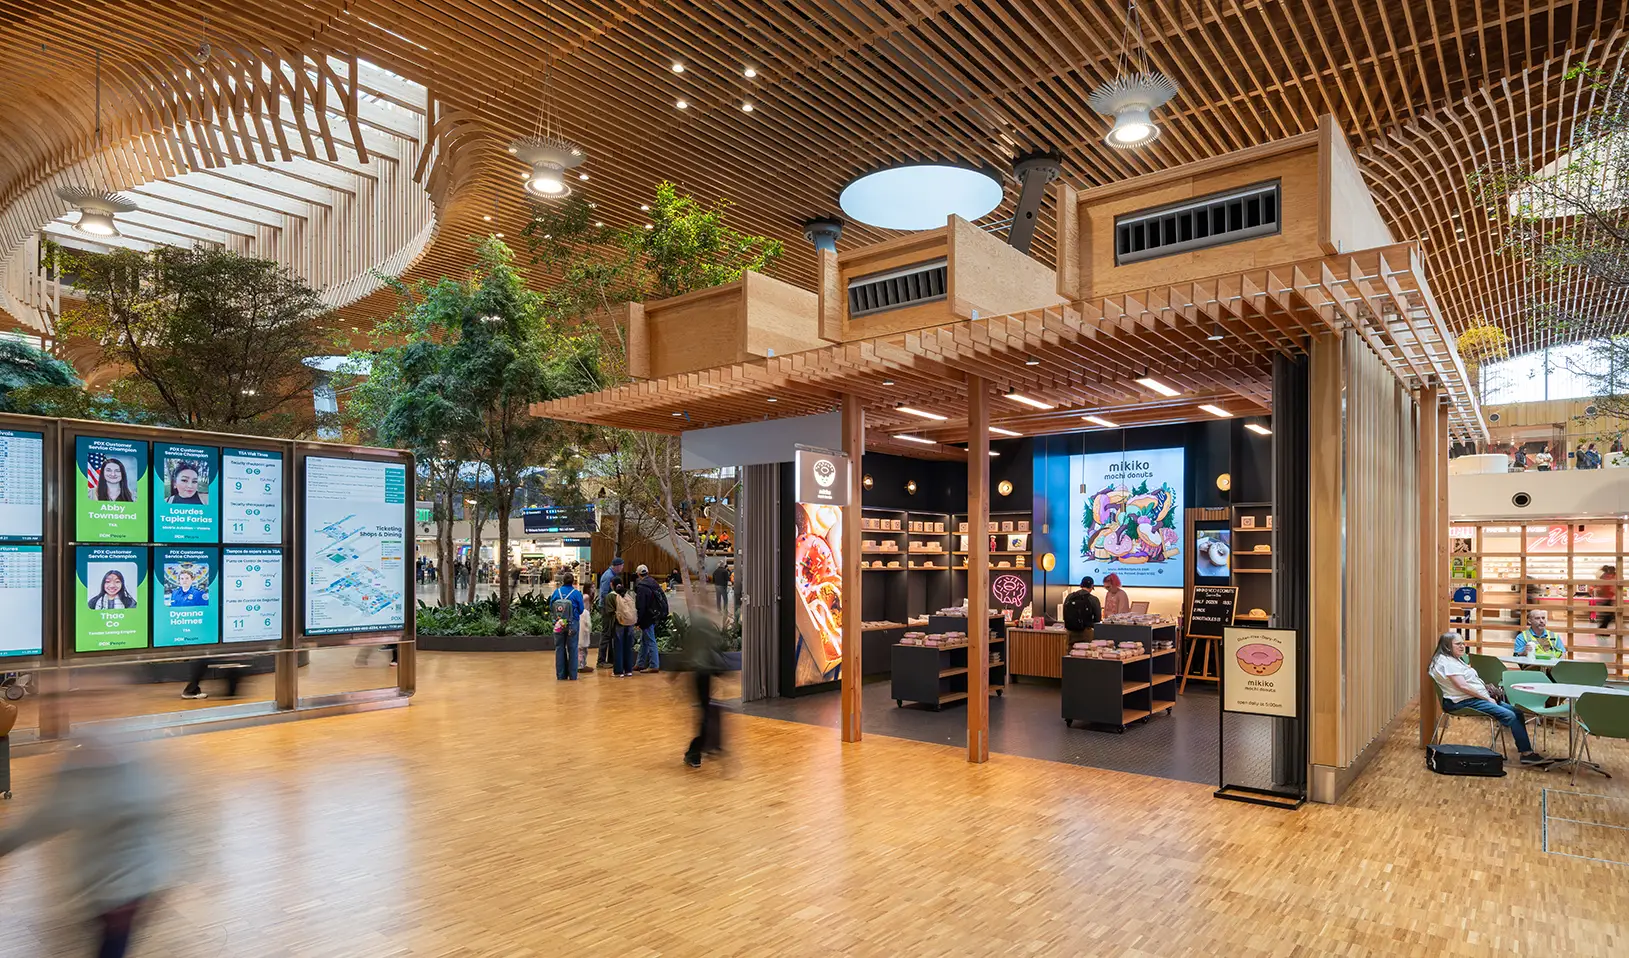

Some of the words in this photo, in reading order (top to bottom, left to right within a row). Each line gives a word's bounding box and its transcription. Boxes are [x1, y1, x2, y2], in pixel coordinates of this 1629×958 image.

[1110, 461, 1149, 471] mikiko
[235, 482, 242, 490] 9
[265, 484, 271, 492] 5
[100, 504, 125, 513] Abby
[264, 524, 271, 532] 6
[236, 580, 242, 588] 9
[265, 579, 271, 587] 5
[233, 619, 244, 628] 11
[264, 618, 271, 626] 6
